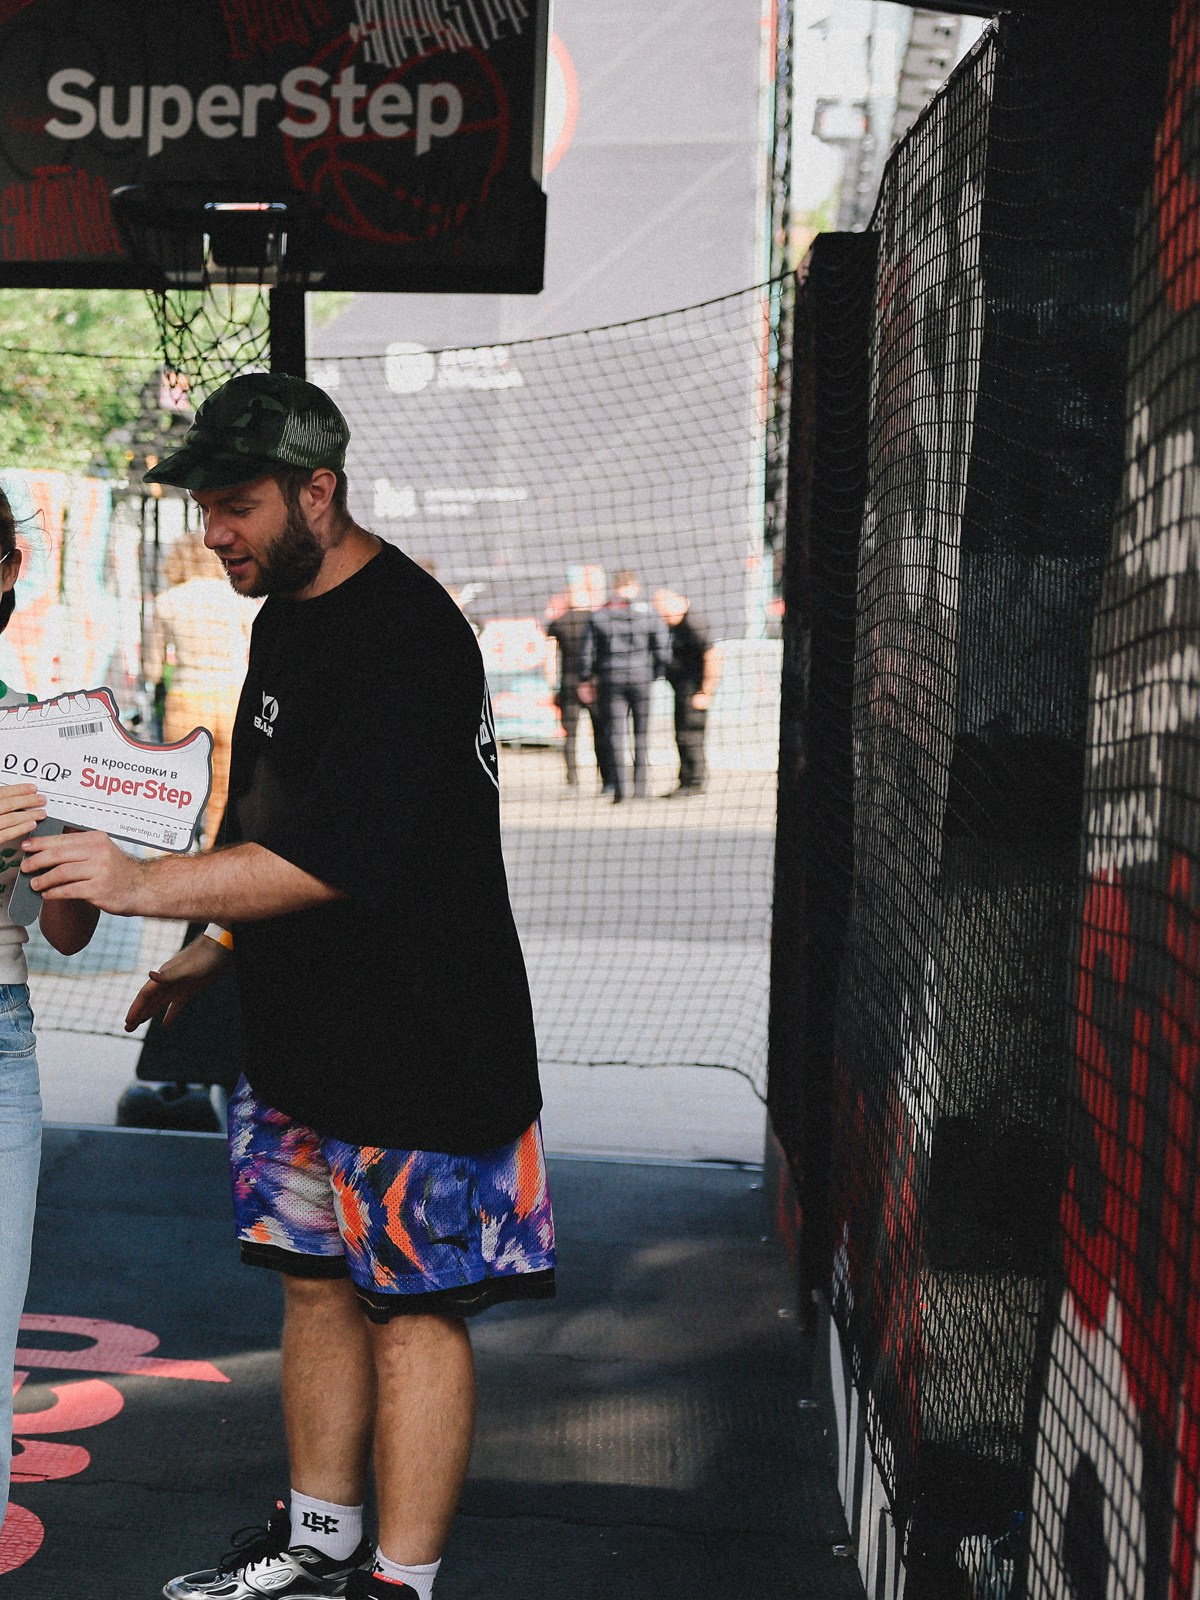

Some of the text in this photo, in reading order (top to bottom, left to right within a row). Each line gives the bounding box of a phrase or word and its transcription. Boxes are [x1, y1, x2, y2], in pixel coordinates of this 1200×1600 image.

[45, 65, 464, 157] SuperStep
[83, 754, 178, 779] на кроссовки в
[79, 767, 192, 809] SuperStep
[119, 823, 161, 839] superstep.ru
